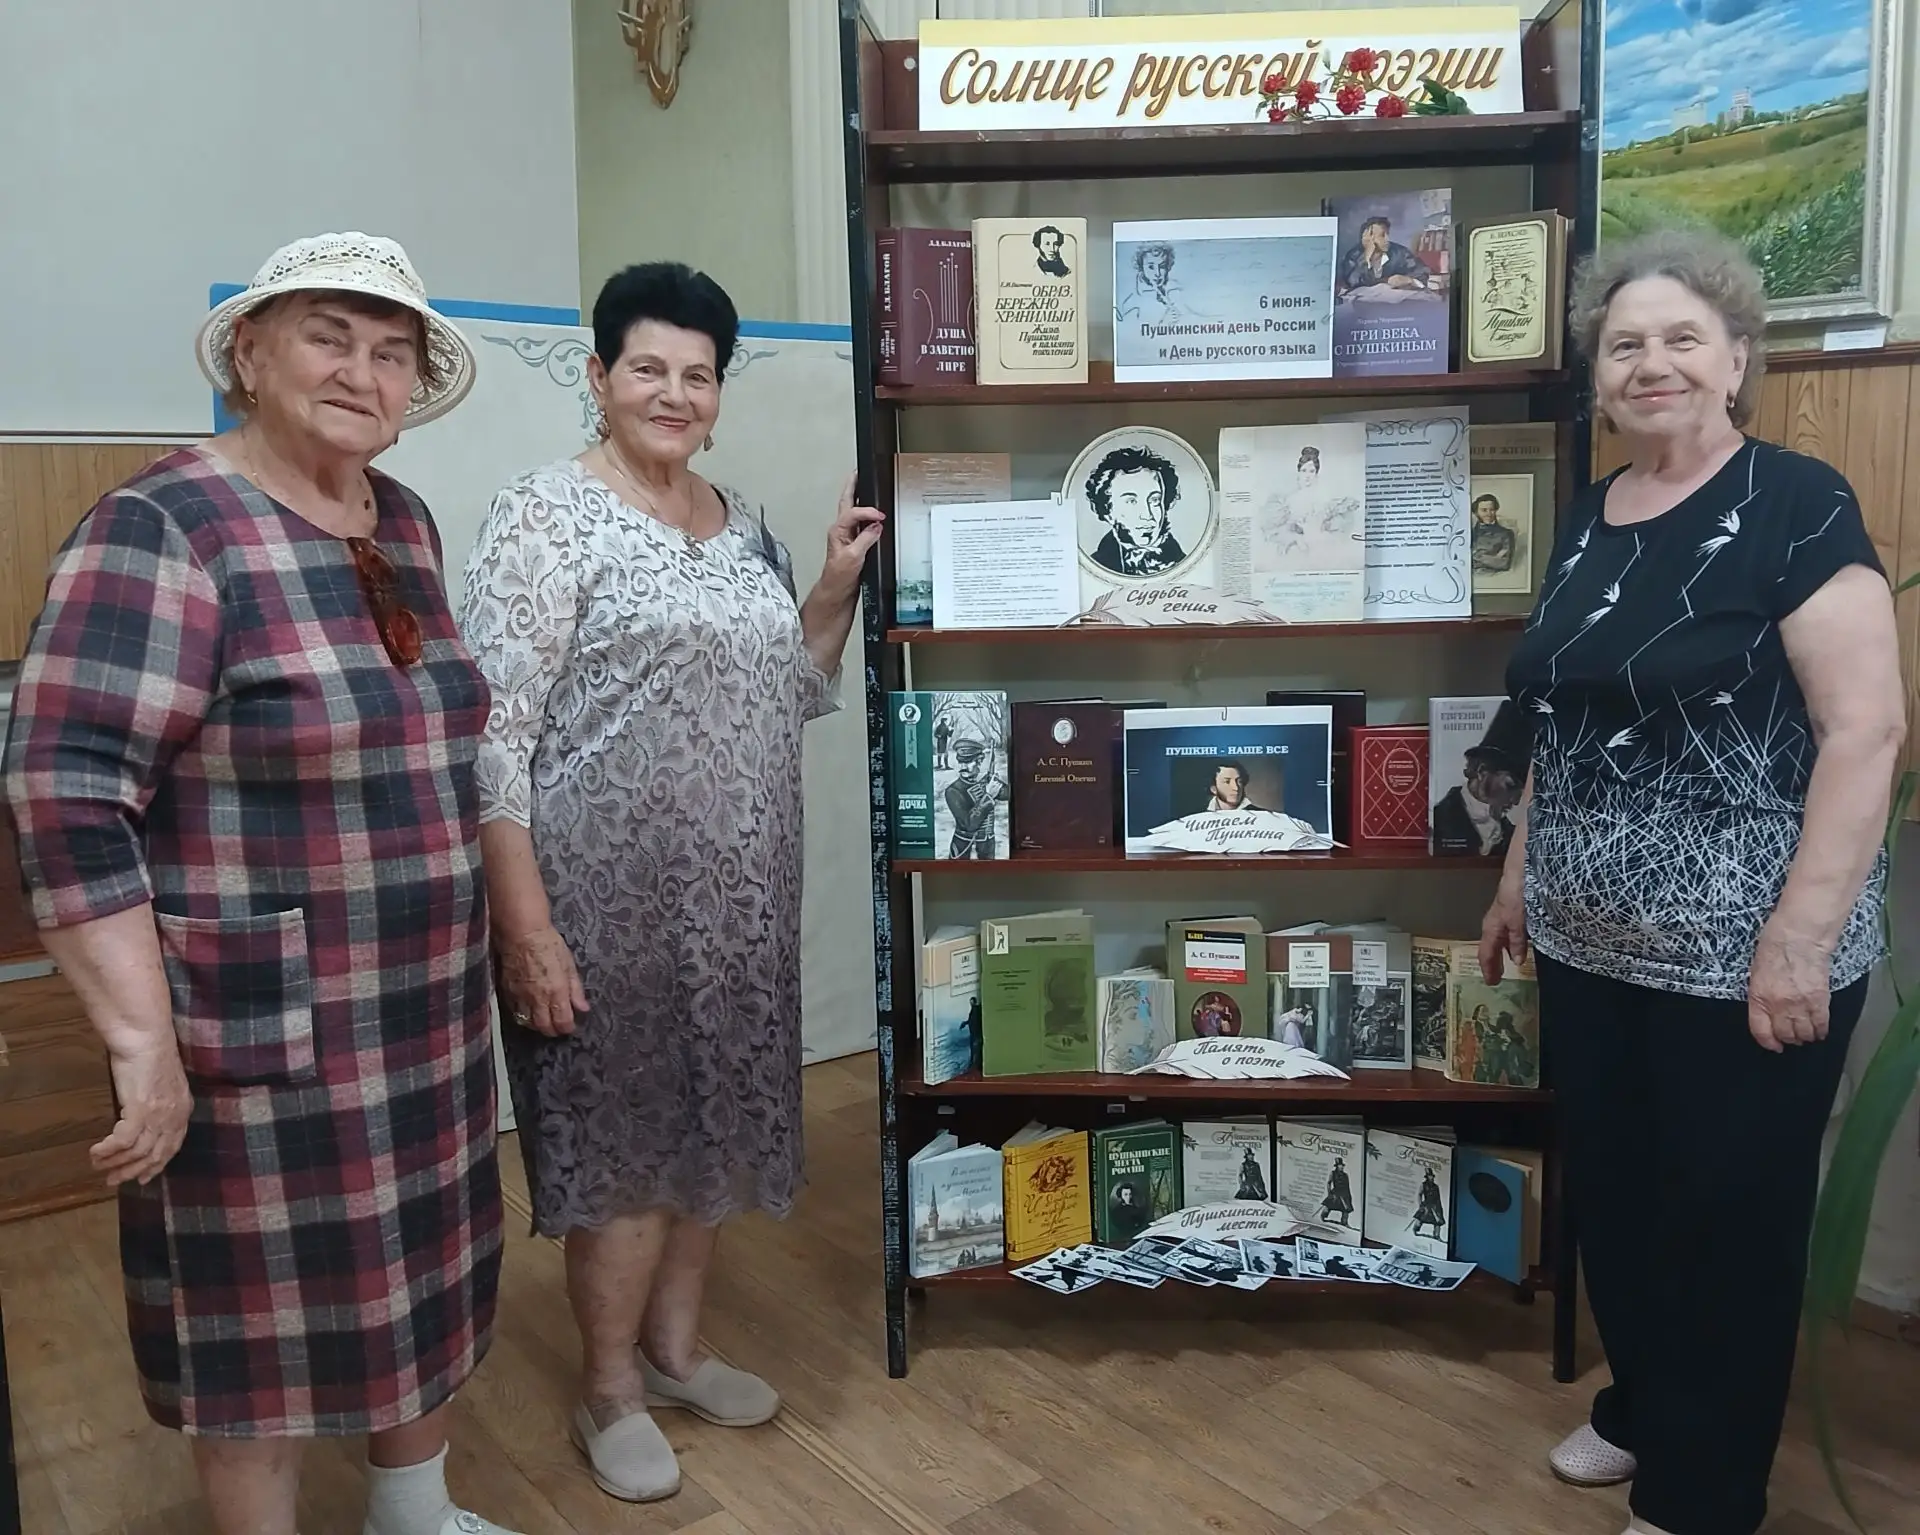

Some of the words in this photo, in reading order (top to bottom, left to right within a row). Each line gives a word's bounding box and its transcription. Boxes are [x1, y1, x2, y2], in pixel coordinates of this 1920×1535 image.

[941, 47, 1115, 111] Солнце
[1117, 40, 1320, 118] русской
[995, 297, 1059, 310] БЕРЕЖНО
[1259, 295, 1268, 309] 6
[995, 307, 1075, 322] ХРАНИМЫЙ
[935, 328, 967, 339] ДУША
[1141, 321, 1225, 339] Пушкинский
[1228, 322, 1260, 335] день
[1264, 319, 1316, 332] России
[1350, 329, 1379, 341] ТРИ
[1382, 327, 1420, 340] ВЕКА
[921, 344, 928, 355] В
[929, 344, 975, 356] ЗАВЕТНО
[1159, 348, 1167, 358] и
[1169, 345, 1203, 360] День
[1206, 344, 1266, 359] русского
[1270, 343, 1316, 356] языка
[1334, 344, 1343, 356] С
[1346, 339, 1437, 355] ПУШКИНЫМ
[935, 361, 966, 372] ЛИРЕ
[1126, 586, 1189, 606] Судьба
[1162, 602, 1219, 613] гения
[1165, 746, 1218, 756] ПУШКИН
[1228, 746, 1263, 755] НАШЕ
[1266, 745, 1289, 754] ВСЕ
[1037, 757, 1047, 766] А.
[1048, 757, 1059, 766] С.
[898, 799, 927, 810] ДОЧКА
[1185, 815, 1258, 832] Читаем
[1205, 827, 1285, 846] Пушкина
[1193, 1040, 1265, 1055] Память
[1221, 1056, 1231, 1066] о
[1234, 1056, 1285, 1068] поэте
[1108, 1147, 1172, 1161] ПУШКИНСКИЕ
[1180, 1207, 1277, 1229] Пушкинские
[1216, 1220, 1269, 1232] места
